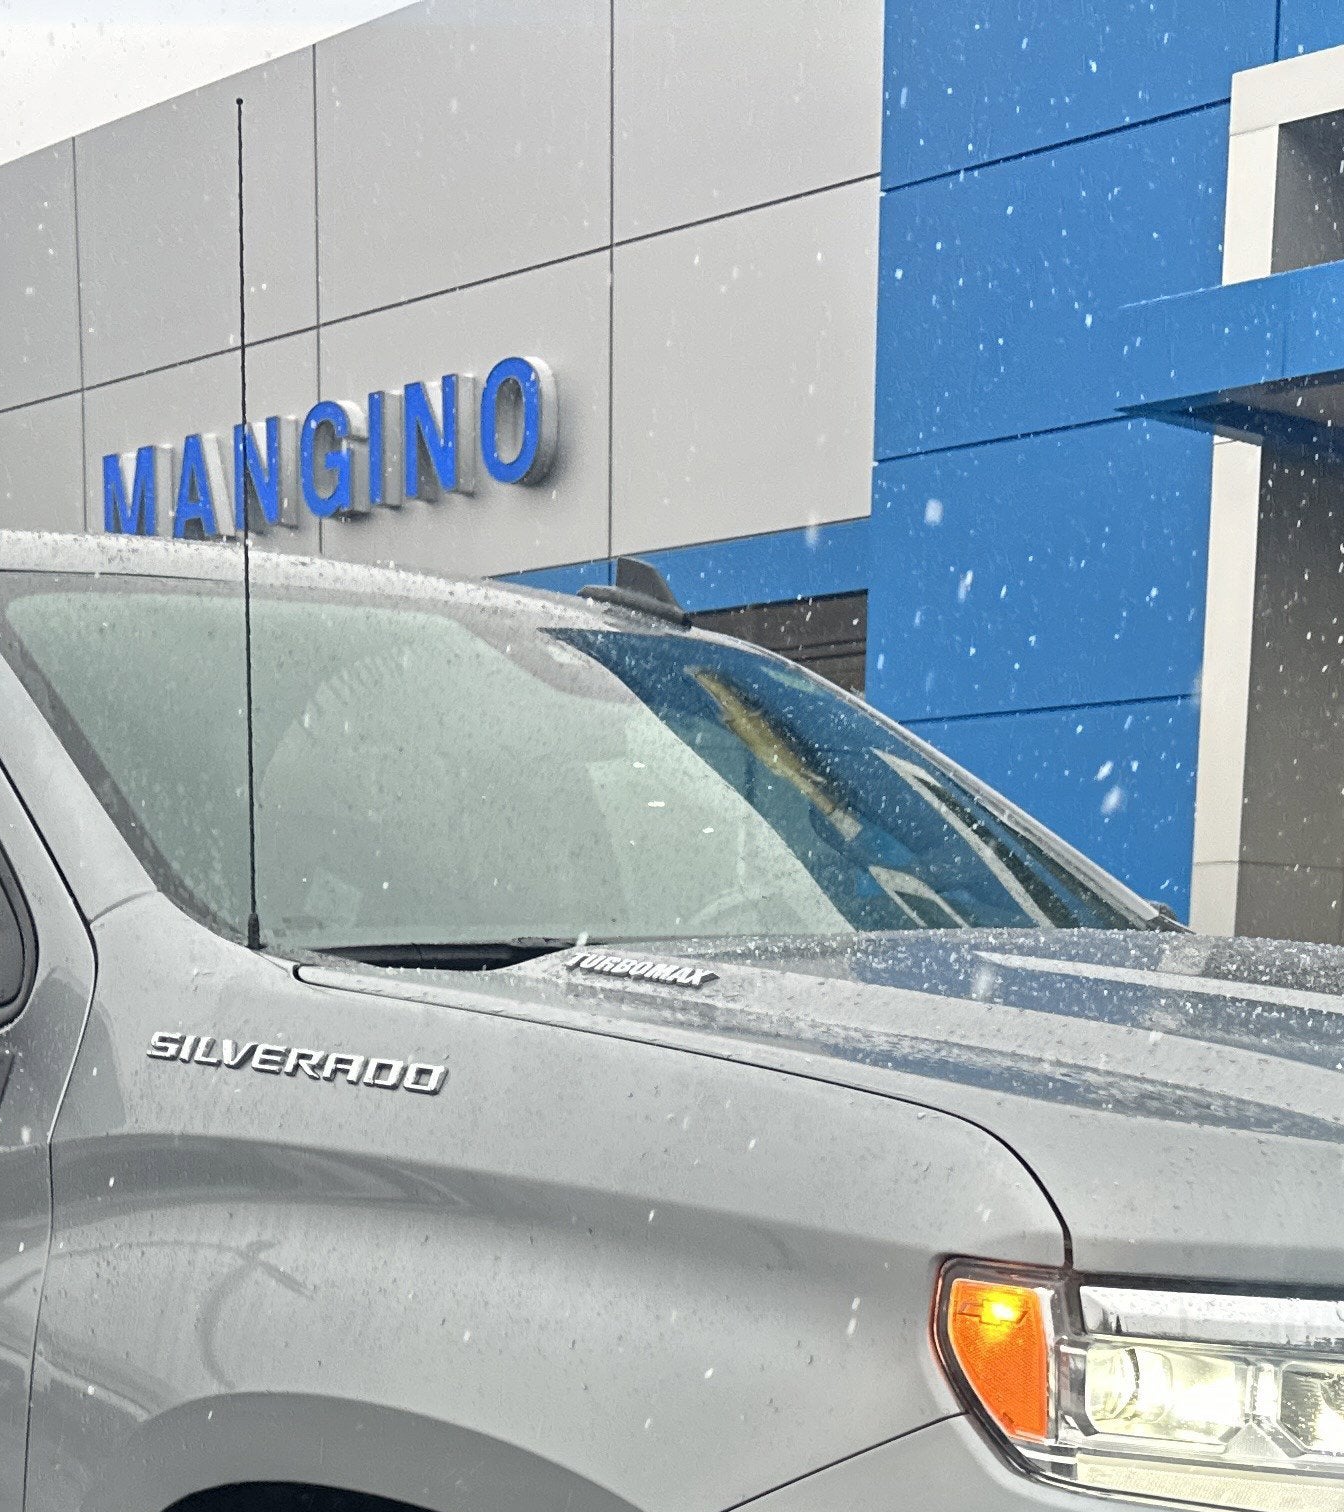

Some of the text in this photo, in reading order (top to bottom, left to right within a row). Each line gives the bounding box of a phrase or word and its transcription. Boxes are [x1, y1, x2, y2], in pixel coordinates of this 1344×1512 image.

[102, 356, 554, 538] MANGINO
[565, 952, 716, 987] TURBOMAX
[147, 1031, 449, 1095] SILVERADO
